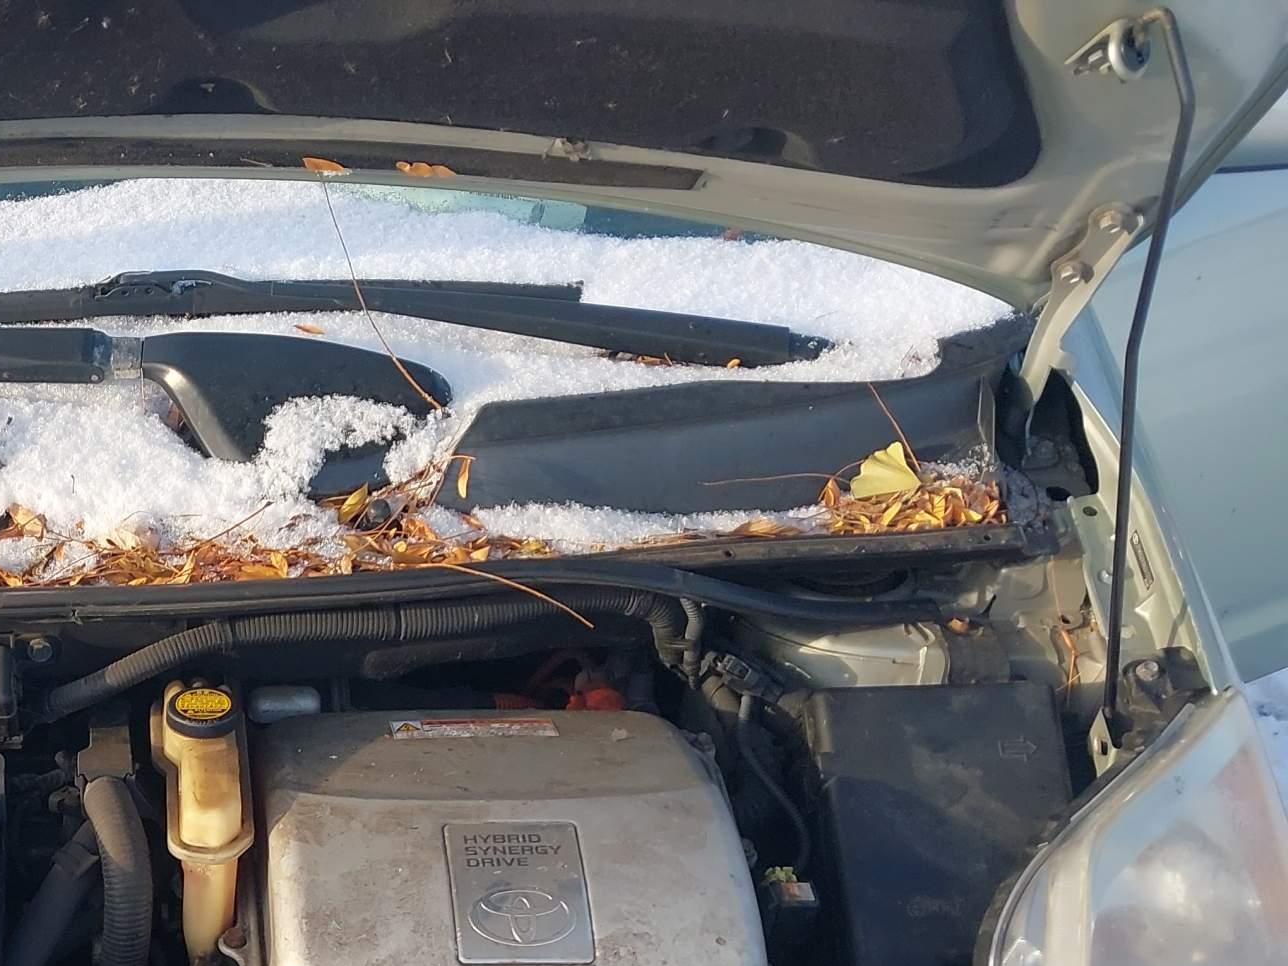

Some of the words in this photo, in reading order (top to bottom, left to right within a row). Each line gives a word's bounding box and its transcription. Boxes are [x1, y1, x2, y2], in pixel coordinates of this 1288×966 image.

[464, 833, 542, 845] HYBRID
[464, 845, 561, 856] SYNERGY
[466, 857, 529, 868] DRIVE
